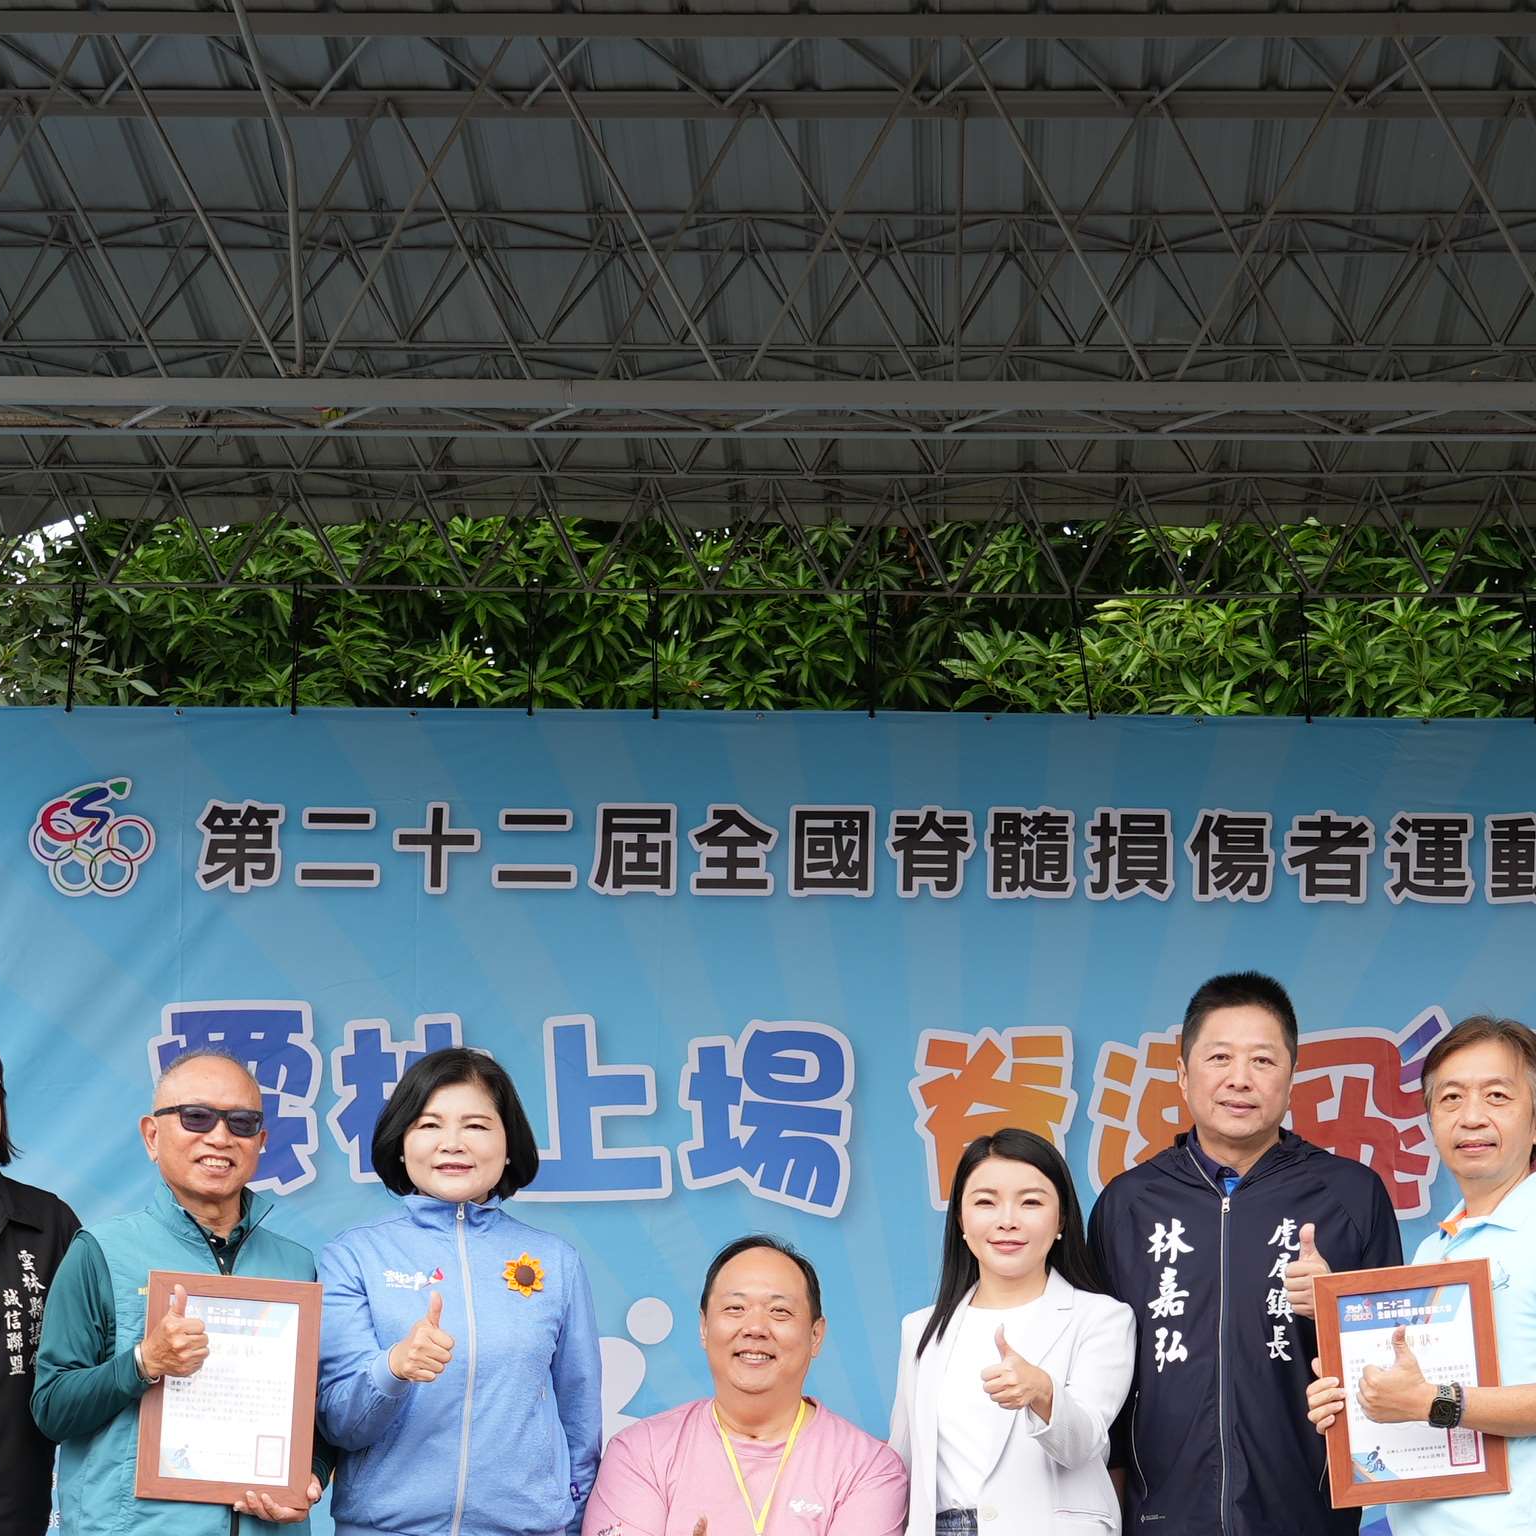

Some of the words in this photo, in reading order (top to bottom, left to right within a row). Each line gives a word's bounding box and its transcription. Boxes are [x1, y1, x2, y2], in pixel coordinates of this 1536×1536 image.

[2, 1288, 26, 1376] 誠信聯盟
[1147, 1218, 1195, 1373] 林嘉弘
[1265, 1217, 1302, 1362] 虎尾鎮長
